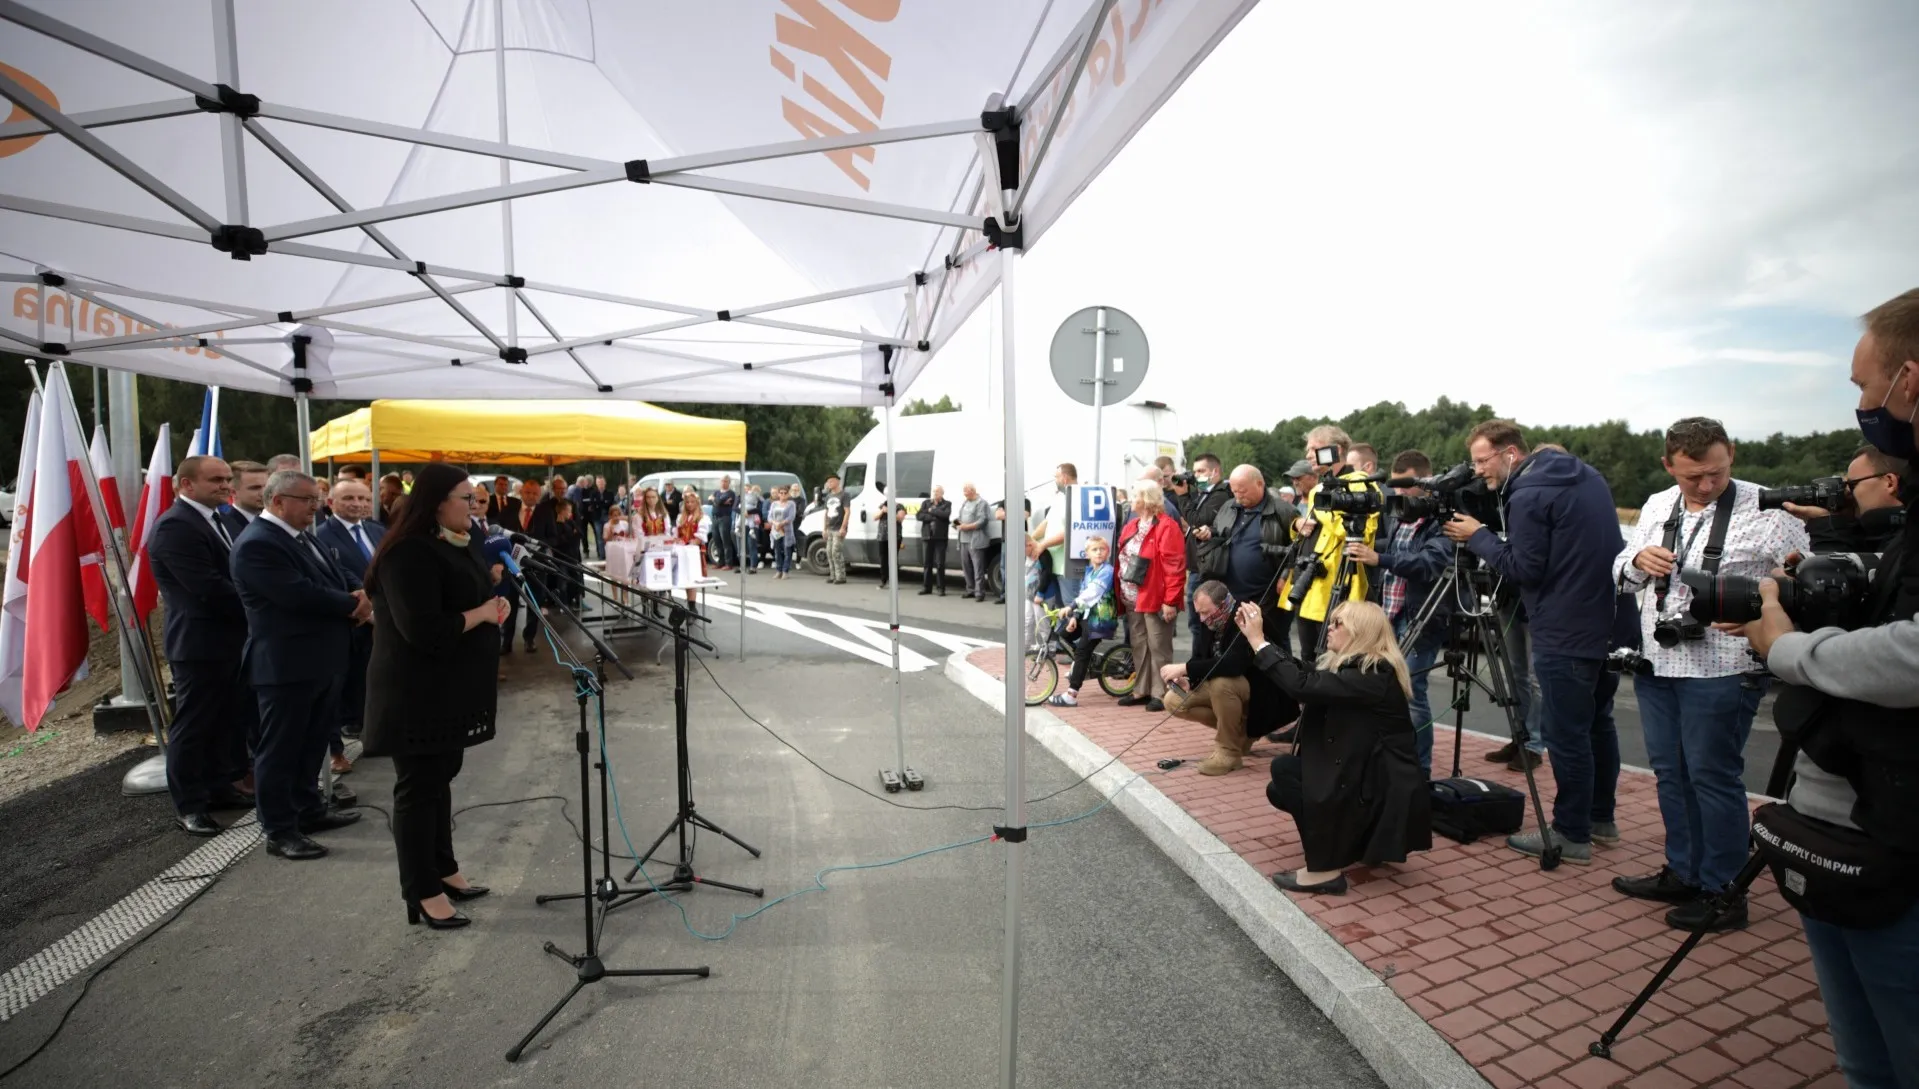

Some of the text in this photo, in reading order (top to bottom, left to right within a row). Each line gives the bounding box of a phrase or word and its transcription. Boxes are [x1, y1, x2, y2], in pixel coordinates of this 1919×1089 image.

[1088, 490, 1105, 518] P
[1073, 521, 1115, 531] PARKING
[1782, 841, 1810, 861] SUPPLY
[1810, 853, 1862, 876] COMPANY
